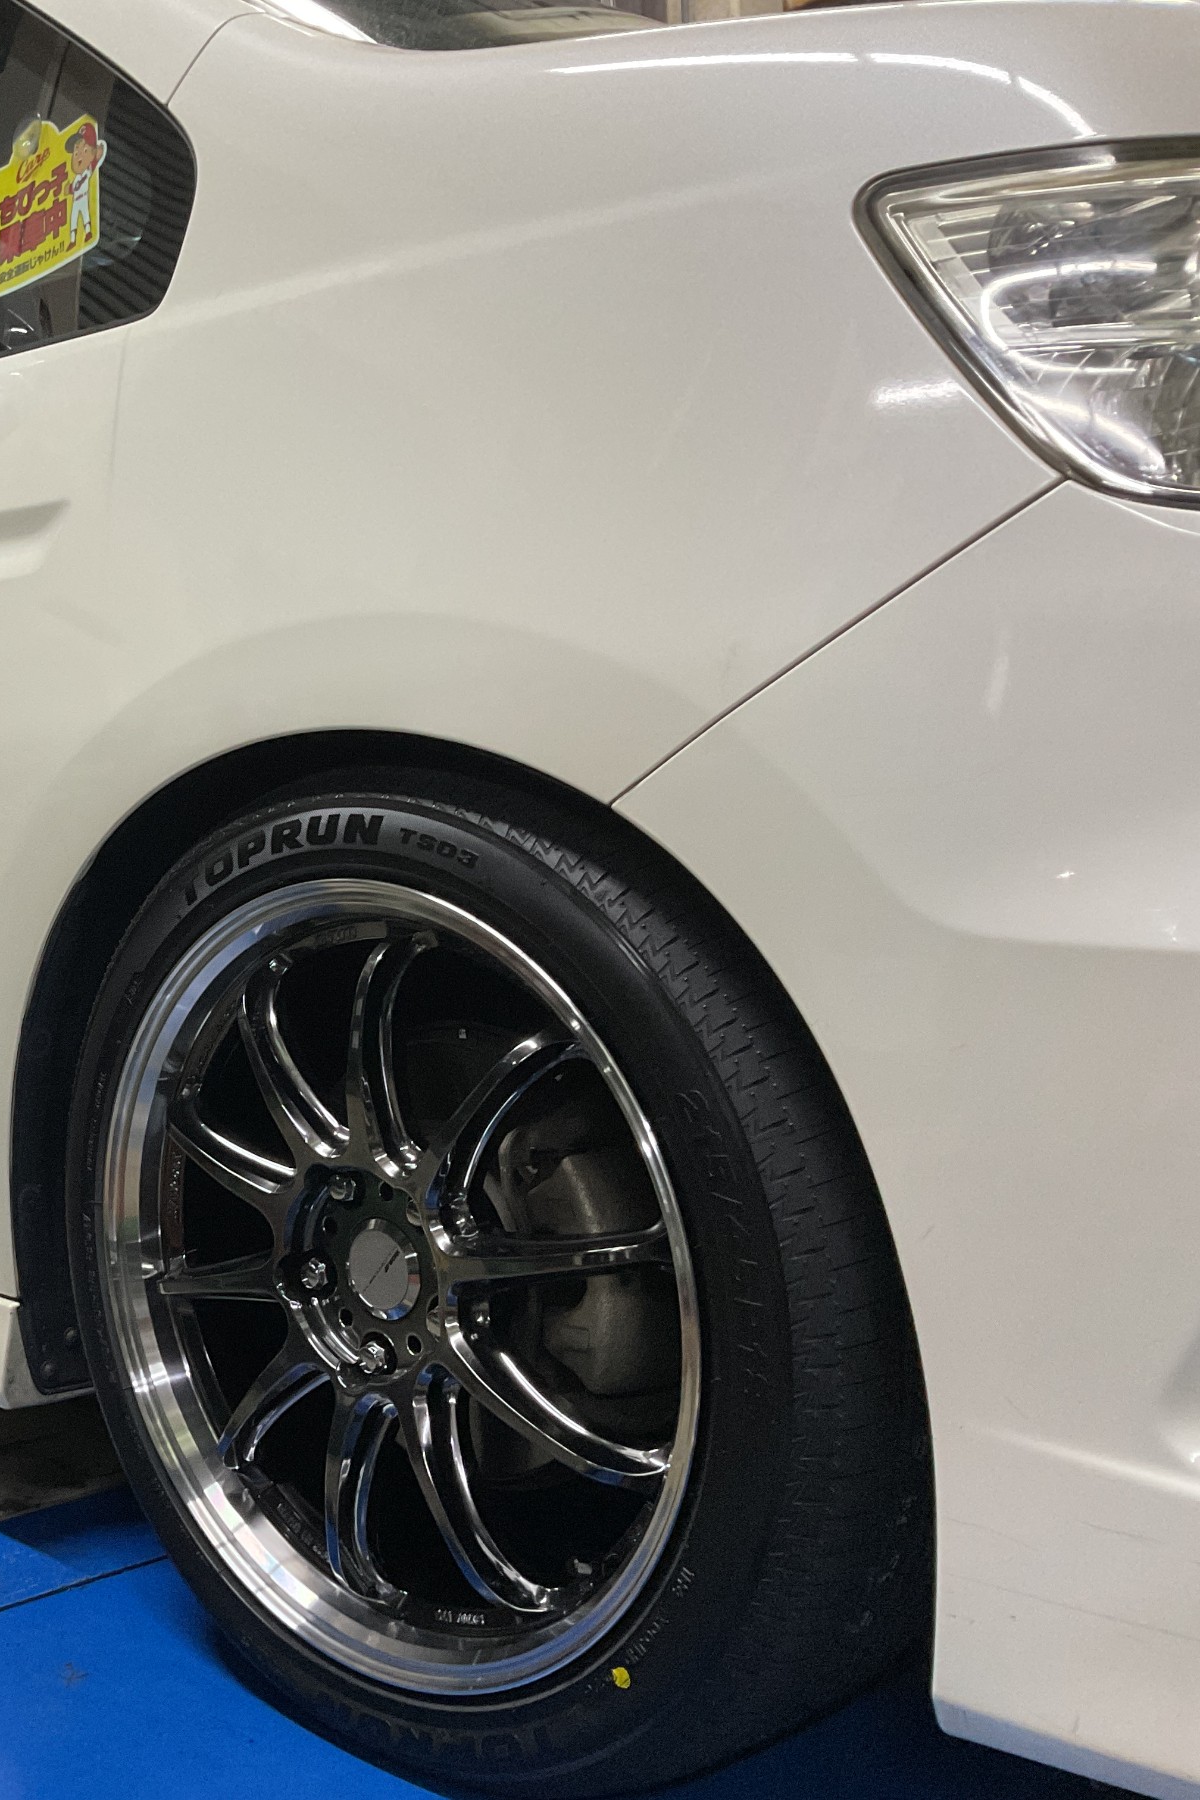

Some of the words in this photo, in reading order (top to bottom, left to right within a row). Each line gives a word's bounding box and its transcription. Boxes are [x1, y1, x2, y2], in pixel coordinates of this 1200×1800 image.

[0, 161, 69, 226] ちびっ子
[182, 813, 385, 906] TOPRUN
[400, 827, 480, 869] TS03
